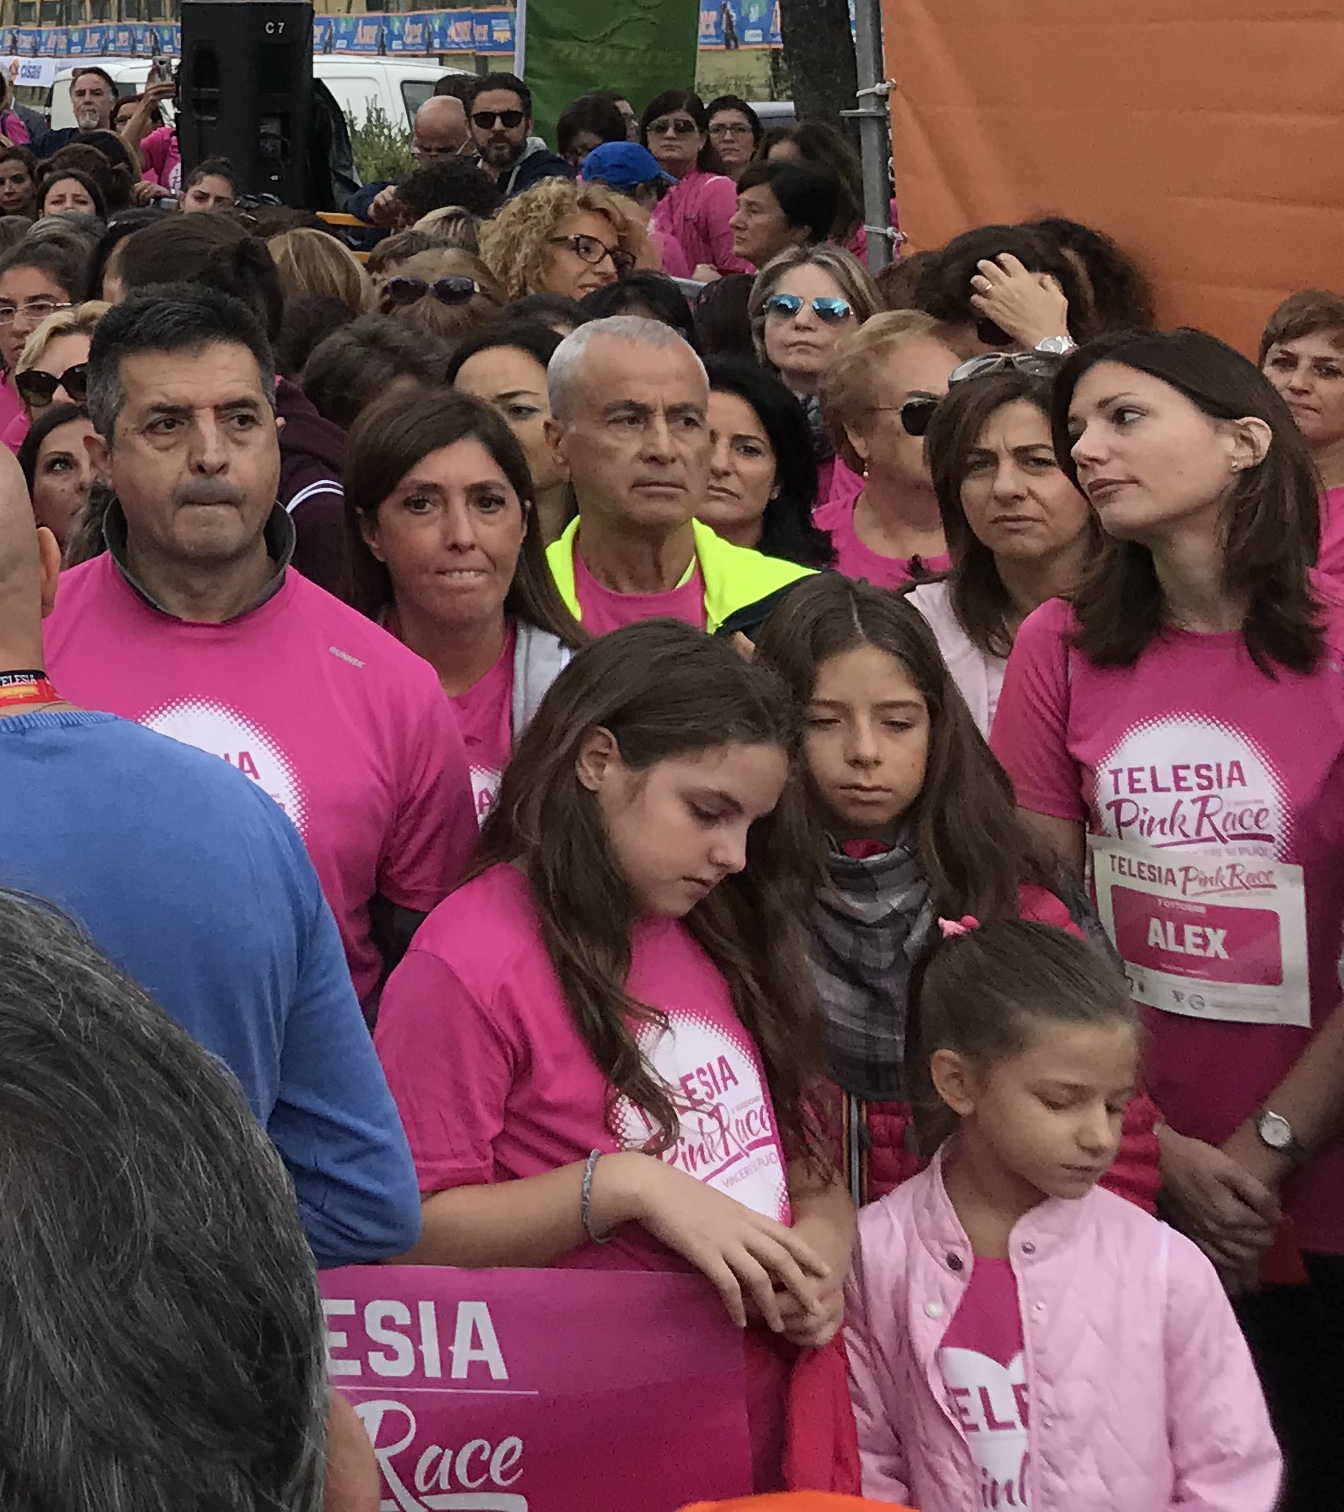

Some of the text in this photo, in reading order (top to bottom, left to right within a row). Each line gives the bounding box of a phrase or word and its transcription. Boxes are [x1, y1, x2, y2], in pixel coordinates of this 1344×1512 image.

[1108, 760, 1249, 796] TELESIA
[1105, 794, 1271, 846] Pink Race
[1109, 854, 1275, 896] TELESIA Pink Race
[1148, 917, 1230, 960] ALEX
